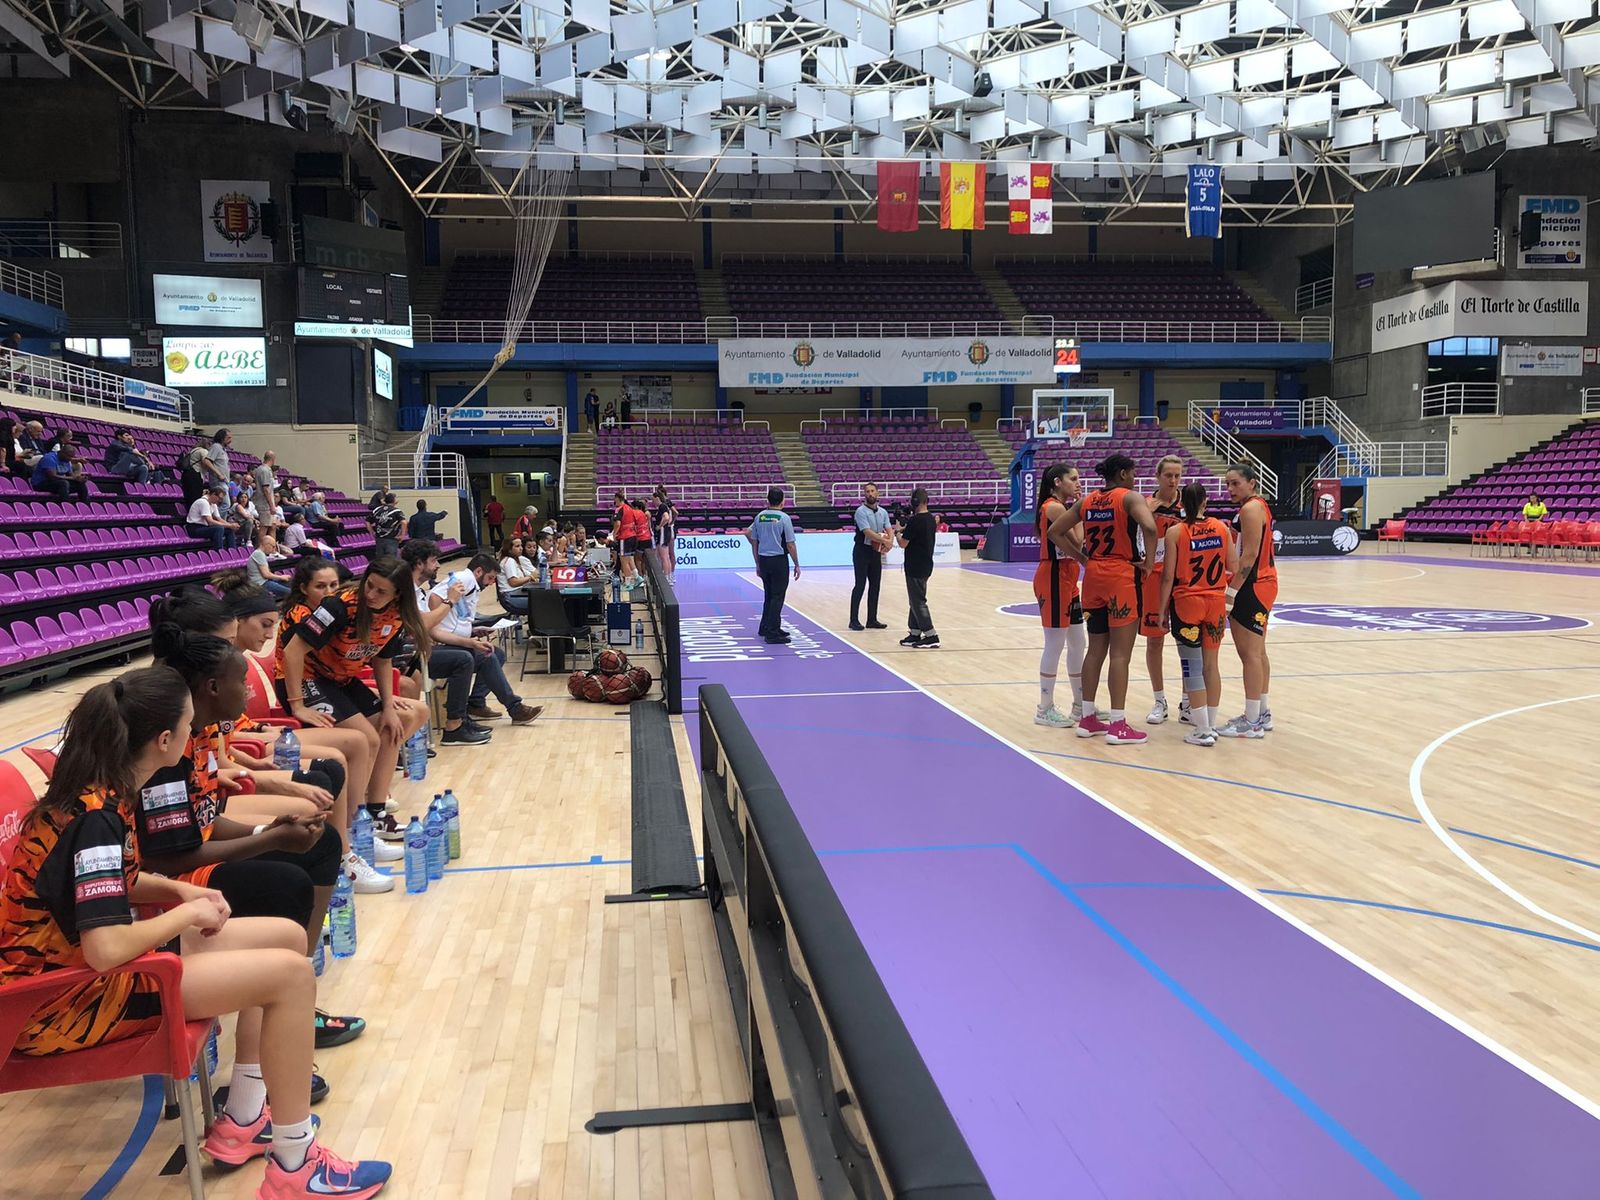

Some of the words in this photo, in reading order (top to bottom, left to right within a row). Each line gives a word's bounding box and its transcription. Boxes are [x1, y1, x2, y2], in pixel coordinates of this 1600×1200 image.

[1194, 169, 1214, 177] LALO
[1200, 188, 1206, 202] 5
[1526, 198, 1580, 214] FMD
[1461, 298, 1476, 314] El
[1482, 298, 1514, 314] Norte
[1518, 298, 1530, 313] de
[1533, 298, 1580, 314] Castilla
[1376, 316, 1386, 332] El
[1388, 313, 1406, 328] Norte
[1409, 309, 1416, 322] de
[1418, 302, 1449, 320] Castilla
[296, 324, 347, 334] Ayuntamiento
[372, 328, 410, 336] Valladolid
[194, 350, 264, 370] ALBE
[724, 350, 785, 360] Ayuntamiento
[822, 350, 834, 358] de
[836, 350, 881, 358] Valladolid
[901, 350, 960, 360] Ayuntamiento
[1008, 349, 1052, 357] Valladolid
[1058, 350, 1078, 365] 24
[748, 372, 784, 384] FMD
[923, 371, 958, 383] FMD
[450, 409, 484, 418] FMD
[676, 538, 740, 549] Baloncesto
[1087, 526, 1115, 557] 33
[676, 553, 698, 564] eón
[558, 568, 576, 580] 5
[1189, 553, 1224, 587] 30
[680, 616, 774, 662] Valladolid
[158, 816, 189, 828] ZAMORA
[85, 885, 122, 896] ZAMORA
